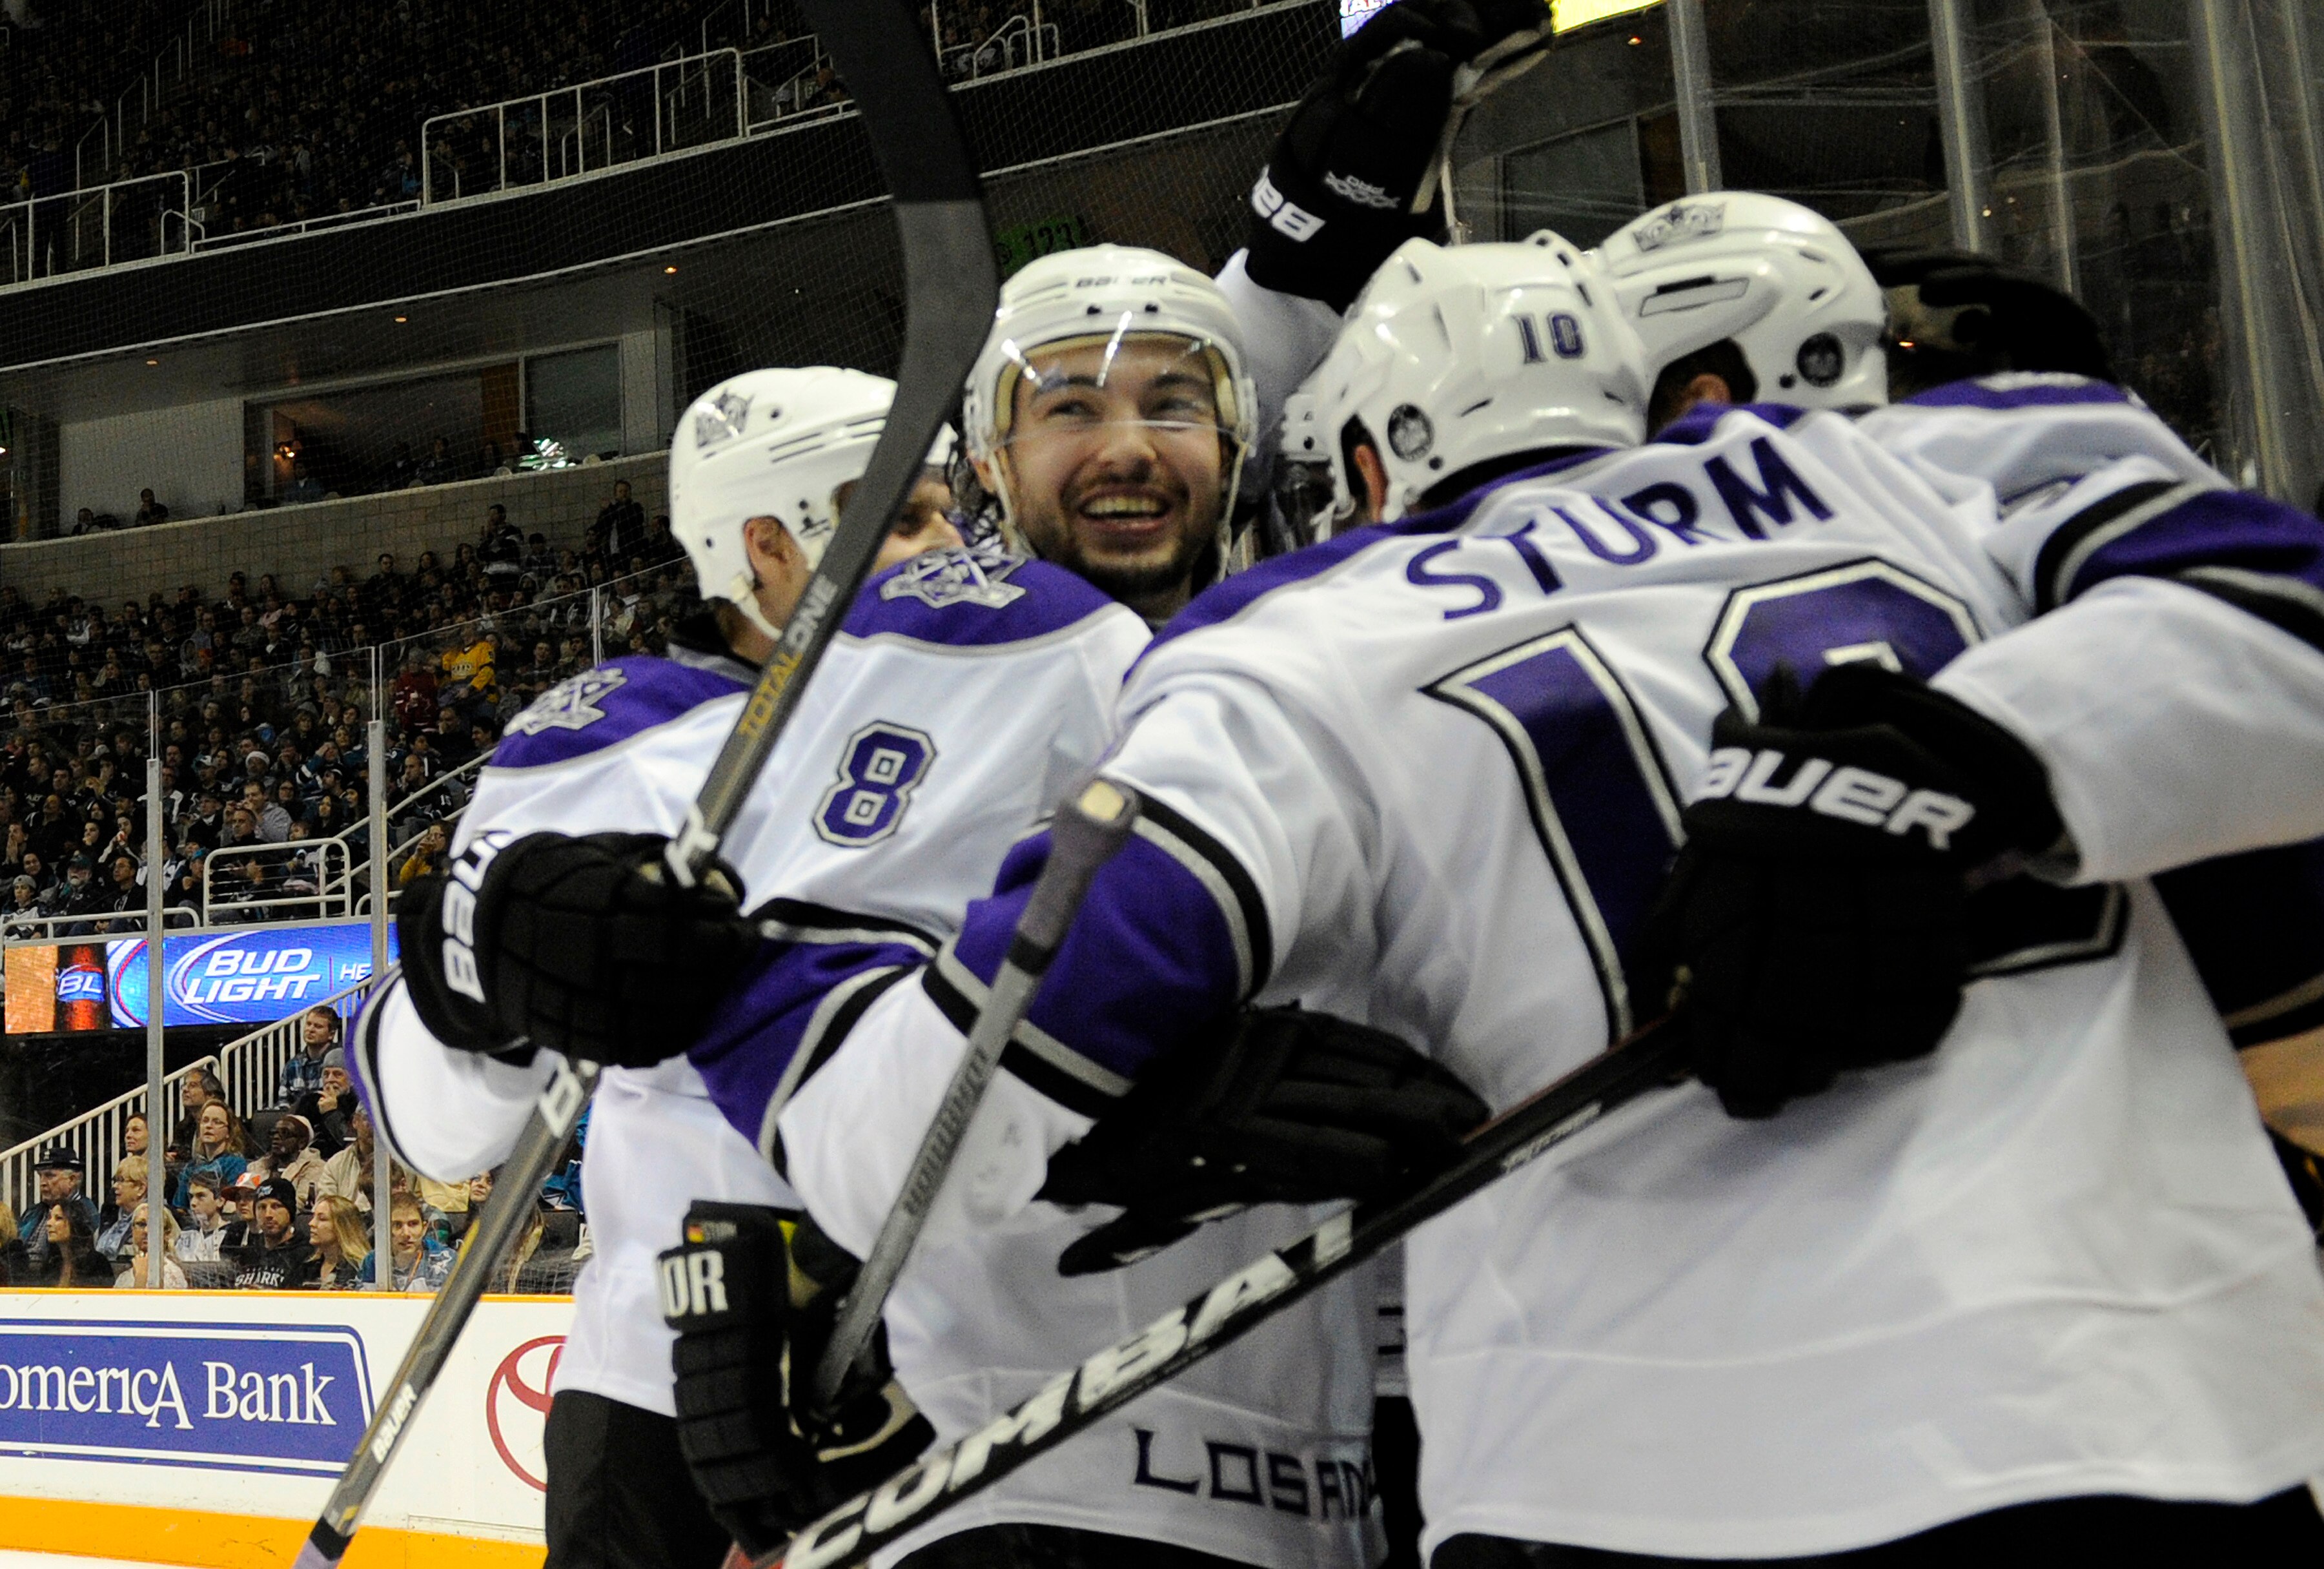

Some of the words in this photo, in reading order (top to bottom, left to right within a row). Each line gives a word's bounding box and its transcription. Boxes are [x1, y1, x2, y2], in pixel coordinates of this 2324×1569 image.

[1077, 276, 1167, 288] BAER
[1511, 311, 1588, 365] 10
[1406, 436, 1834, 620] STURM
[737, 651, 804, 741] TOTAL
[812, 719, 939, 848] 8
[58, 975, 102, 995] BL
[183, 974, 321, 1005] LIGHT
[204, 948, 313, 978] BUD
[202, 1361, 337, 1426] Bank
